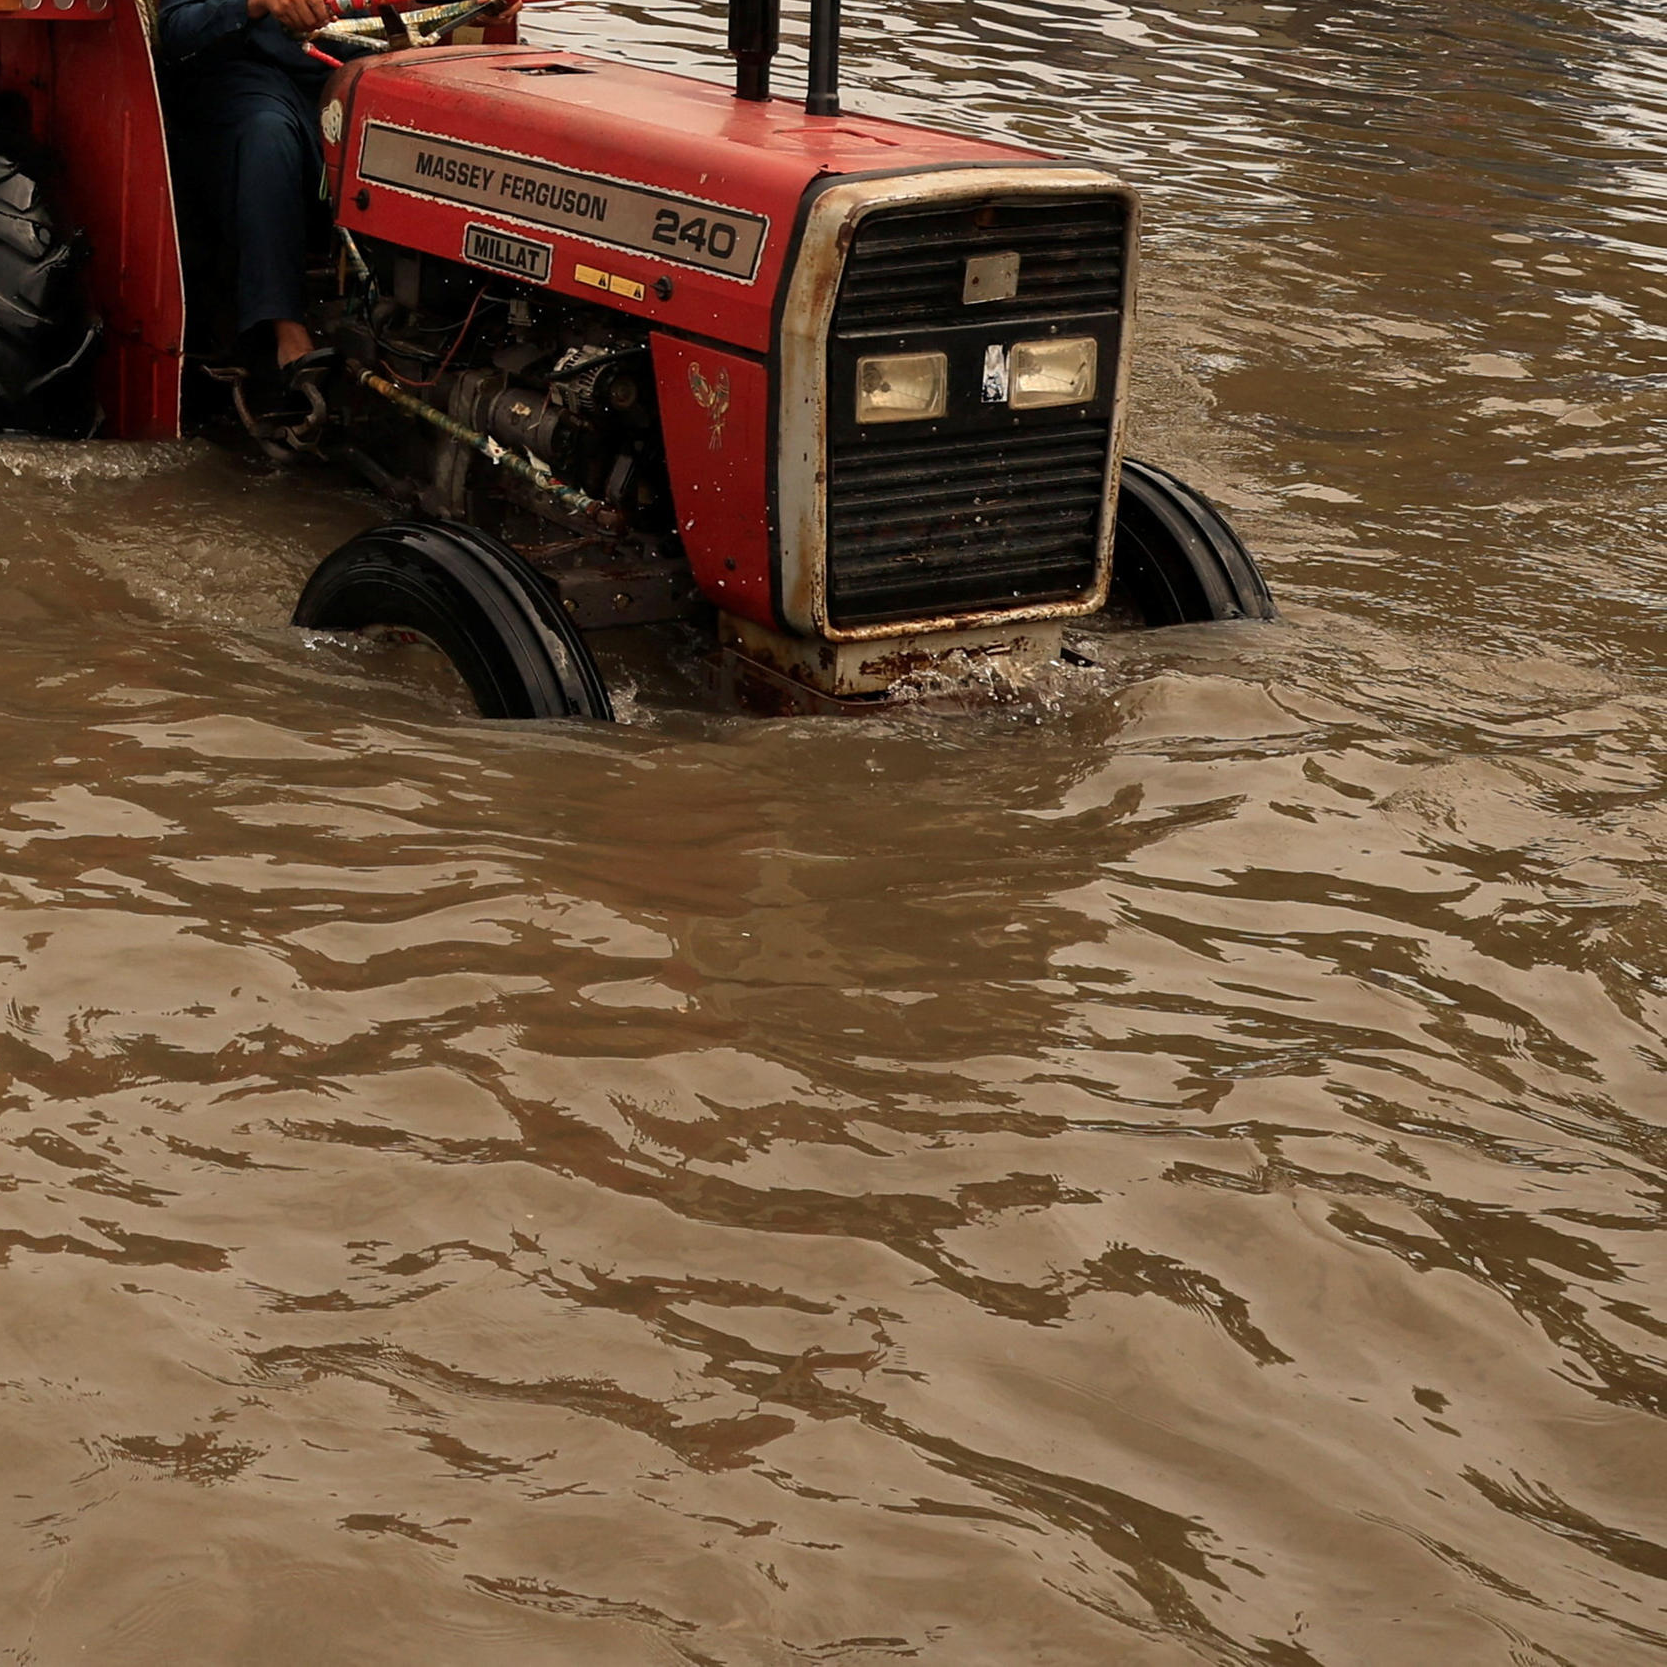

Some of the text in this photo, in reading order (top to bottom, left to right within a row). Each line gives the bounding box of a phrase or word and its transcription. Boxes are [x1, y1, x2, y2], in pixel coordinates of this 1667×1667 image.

[415, 151, 737, 260] MASSEY FERGUSON 240
[473, 233, 540, 273] MILLAT
